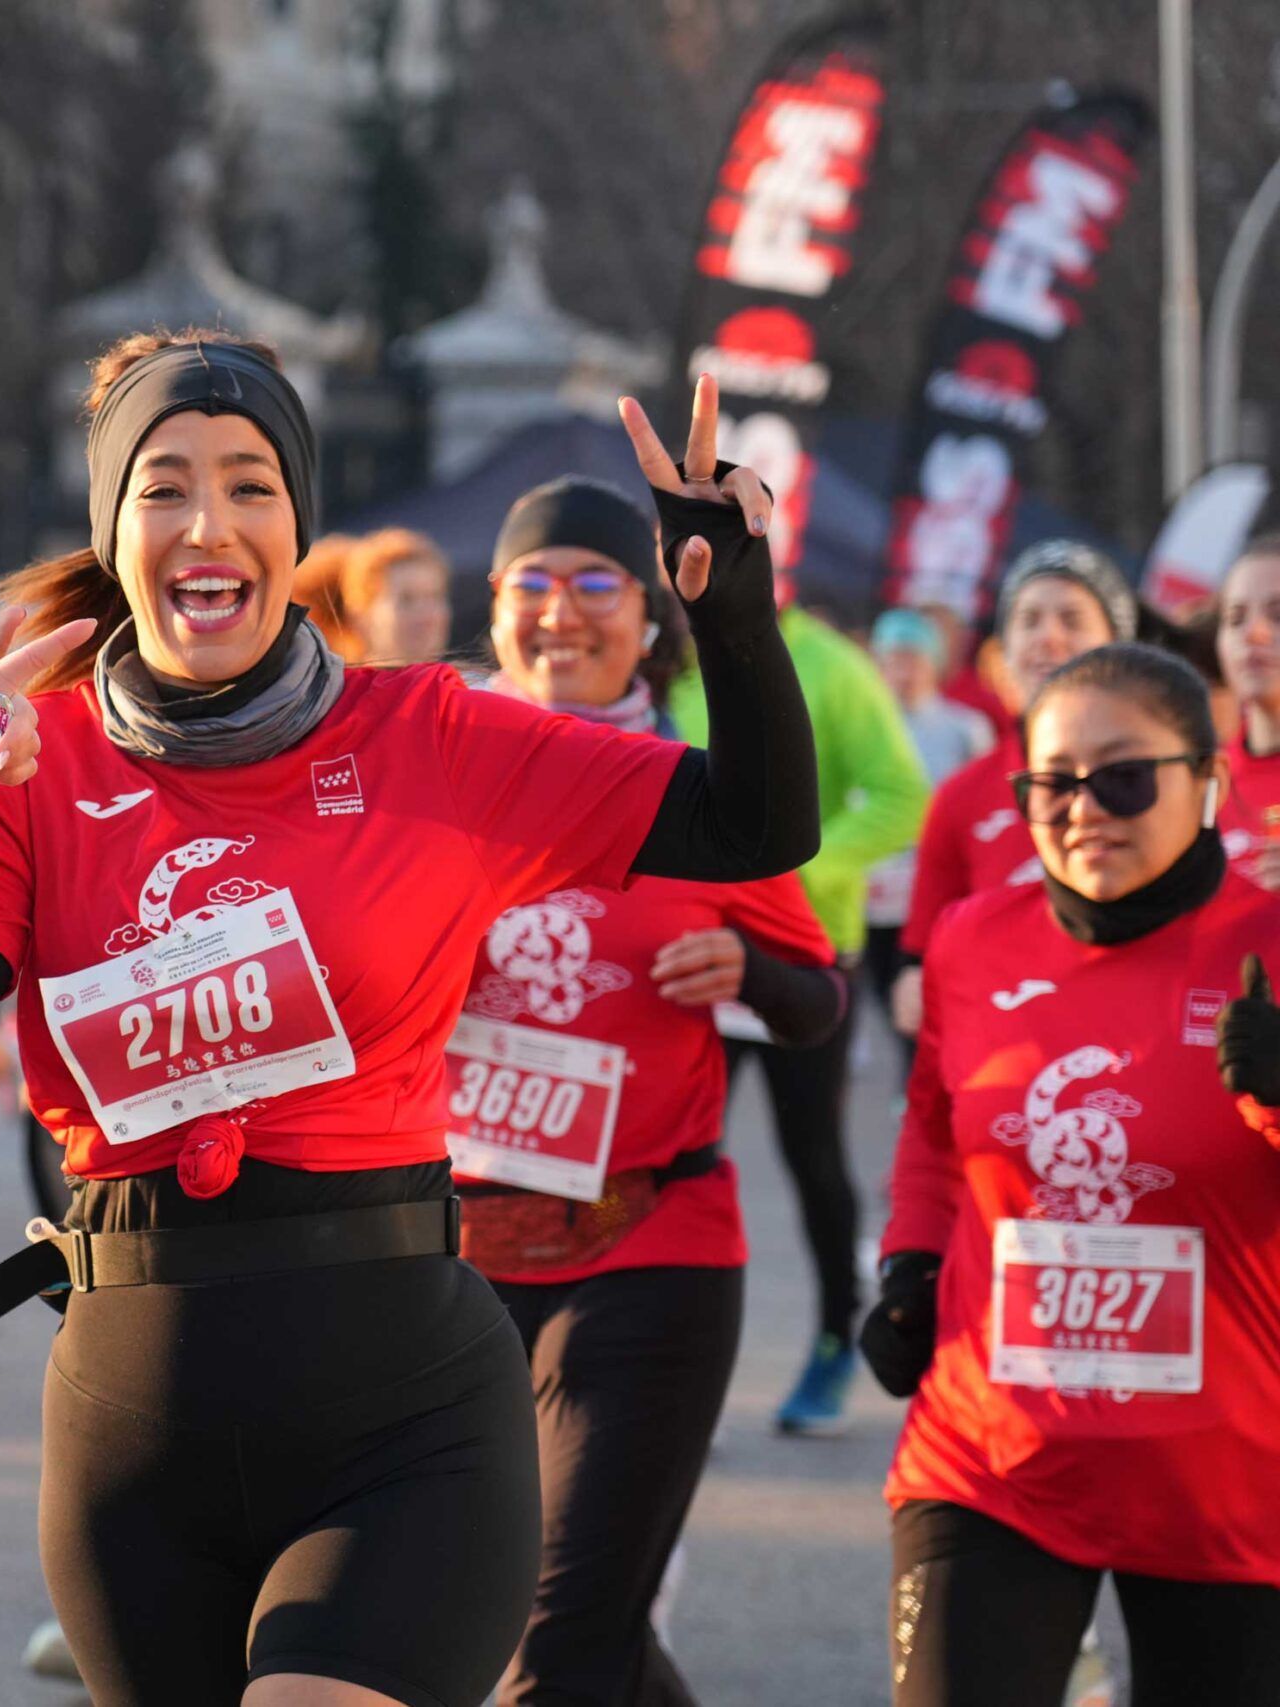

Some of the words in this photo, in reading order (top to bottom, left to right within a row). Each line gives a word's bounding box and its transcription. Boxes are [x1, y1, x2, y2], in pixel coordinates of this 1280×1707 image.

[315, 798, 364, 809] Comunidad
[317, 808, 330, 816] de
[331, 805, 364, 815] Madrid
[118, 960, 274, 1071] 2708
[448, 1060, 585, 1140] 3690
[1031, 1267, 1166, 1333] 3627
